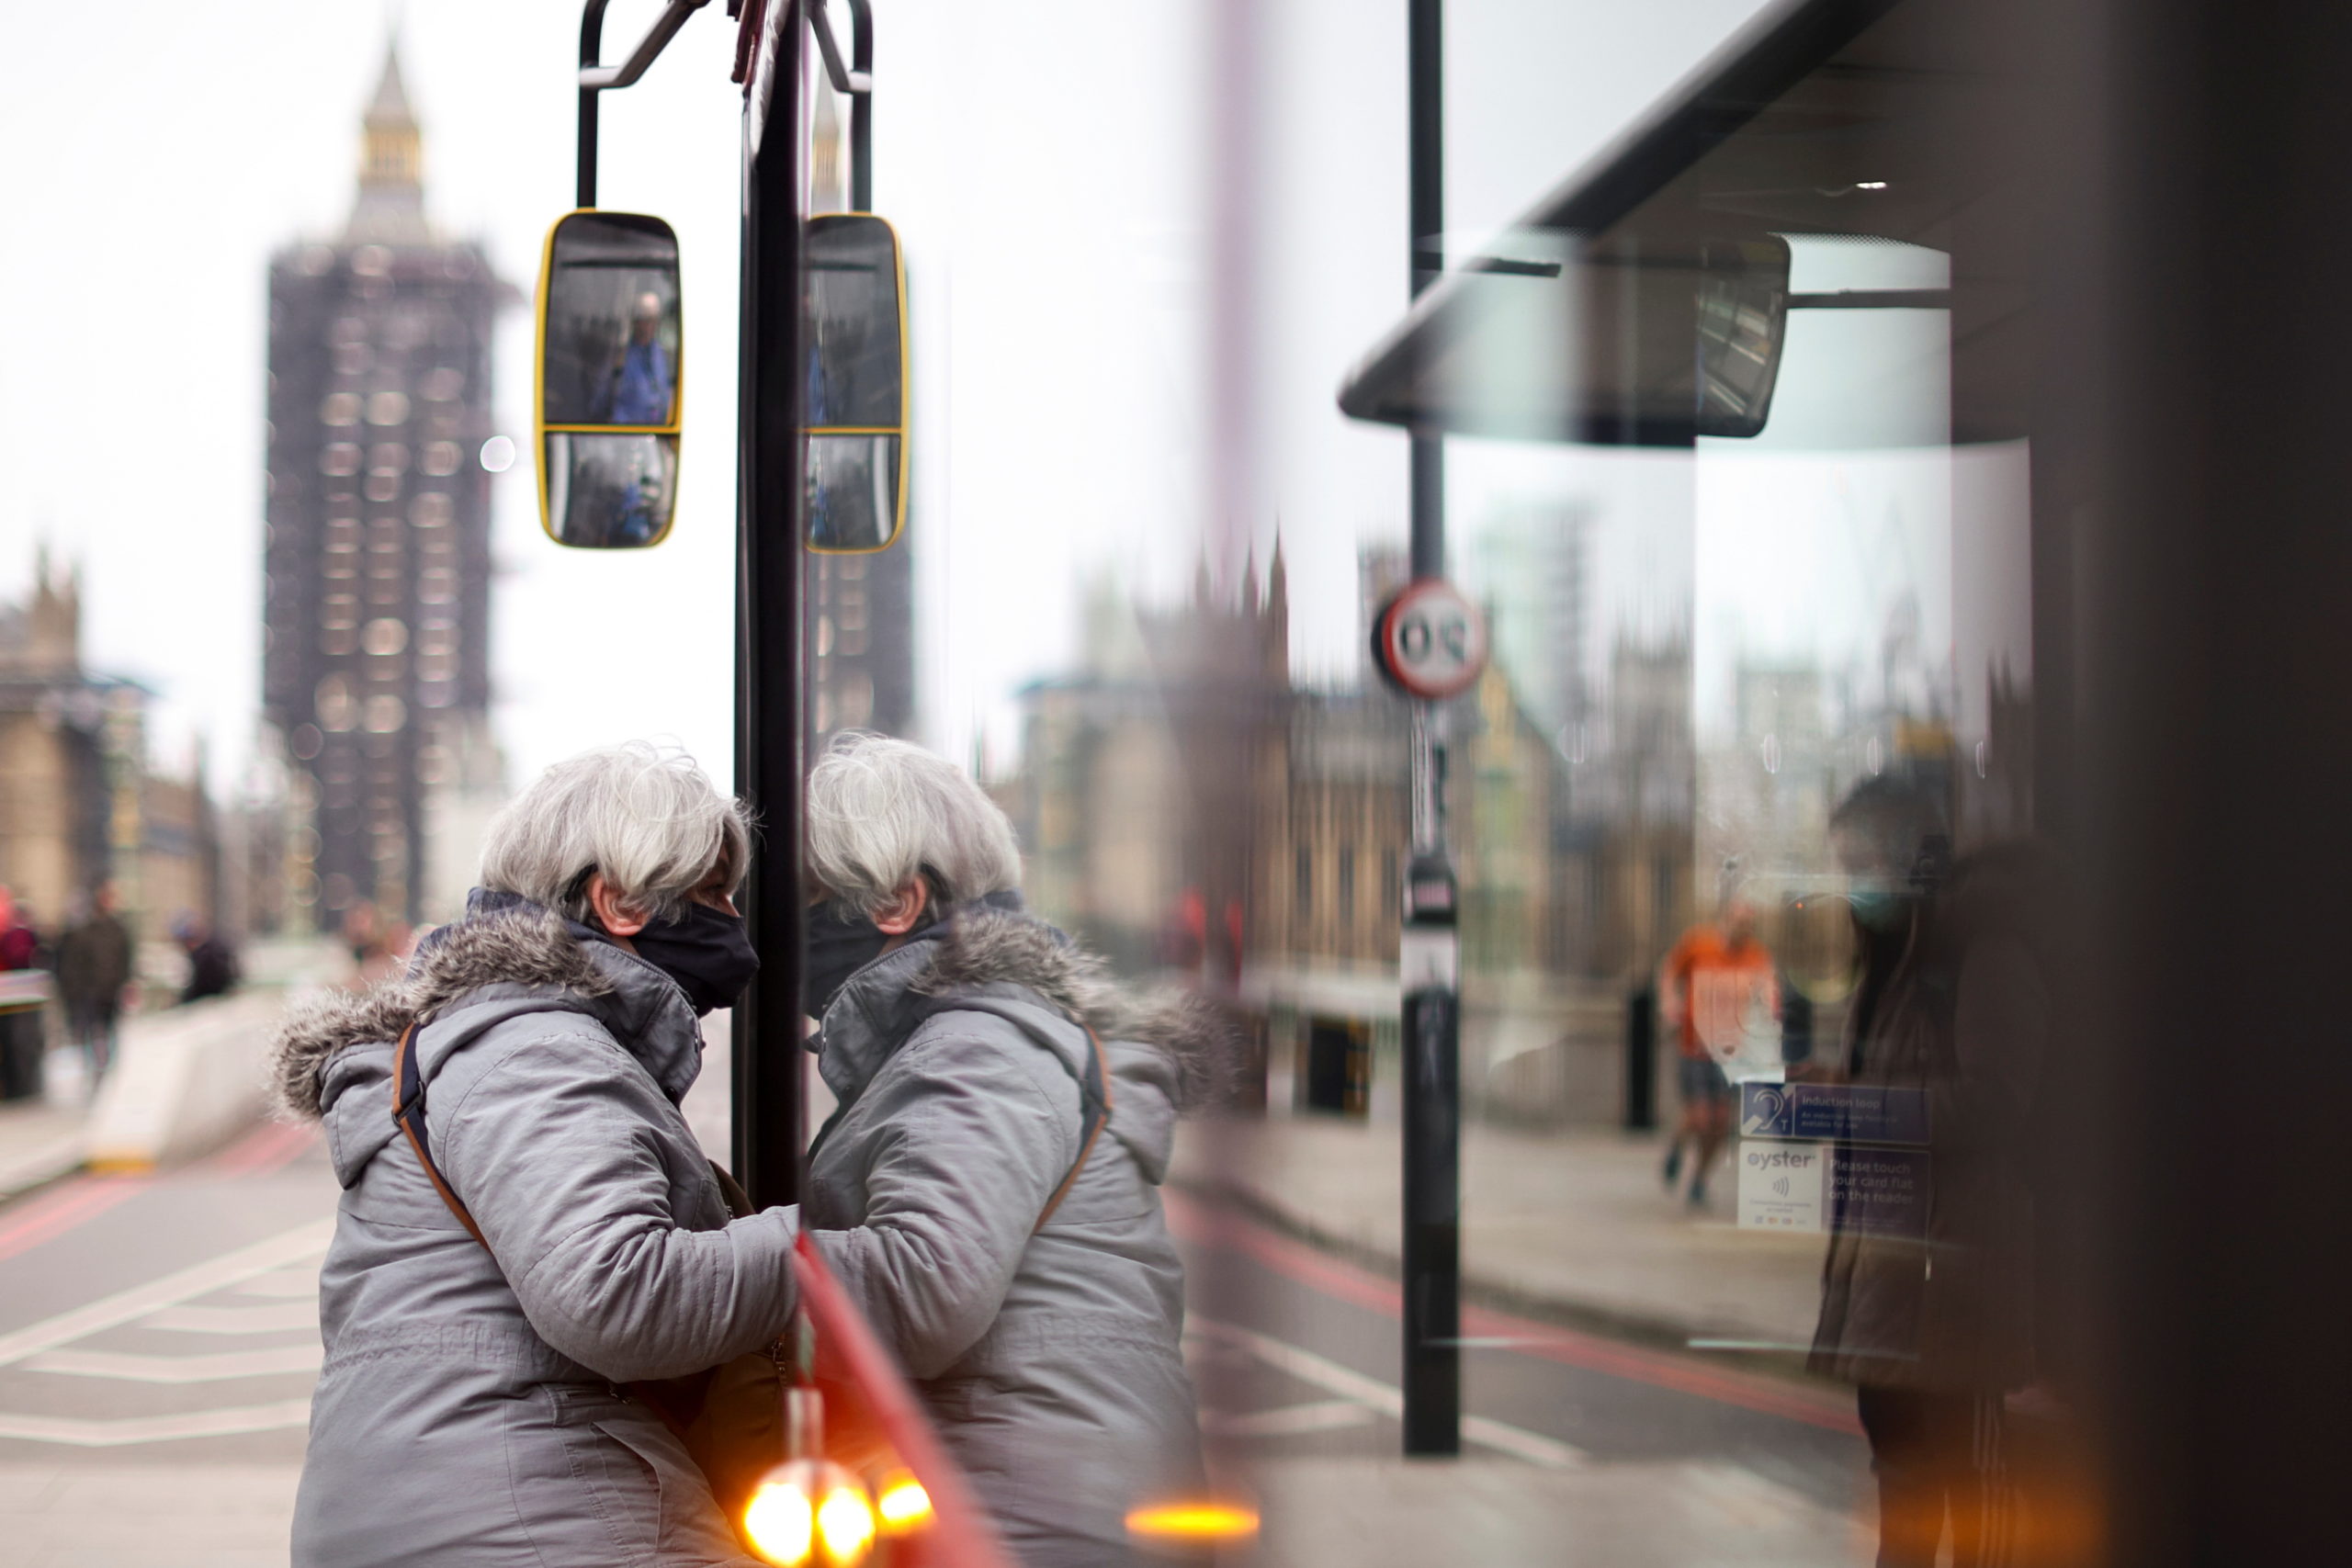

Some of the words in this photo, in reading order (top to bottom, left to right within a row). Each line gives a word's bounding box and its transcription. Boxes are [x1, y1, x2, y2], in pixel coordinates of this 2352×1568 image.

[1802, 1095, 1853, 1108] Induction
[1855, 1098, 1881, 1111] loop
[1747, 1150, 1811, 1170] oyster
[1829, 1158, 1871, 1173] Please
[1873, 1162, 1911, 1175] touch
[1829, 1175, 1857, 1189] your
[1860, 1177, 1888, 1189] card
[1891, 1177, 1915, 1190] flat
[1828, 1190, 1845, 1201] on
[1849, 1189, 1870, 1202] the
[1873, 1192, 1915, 1205] reader
